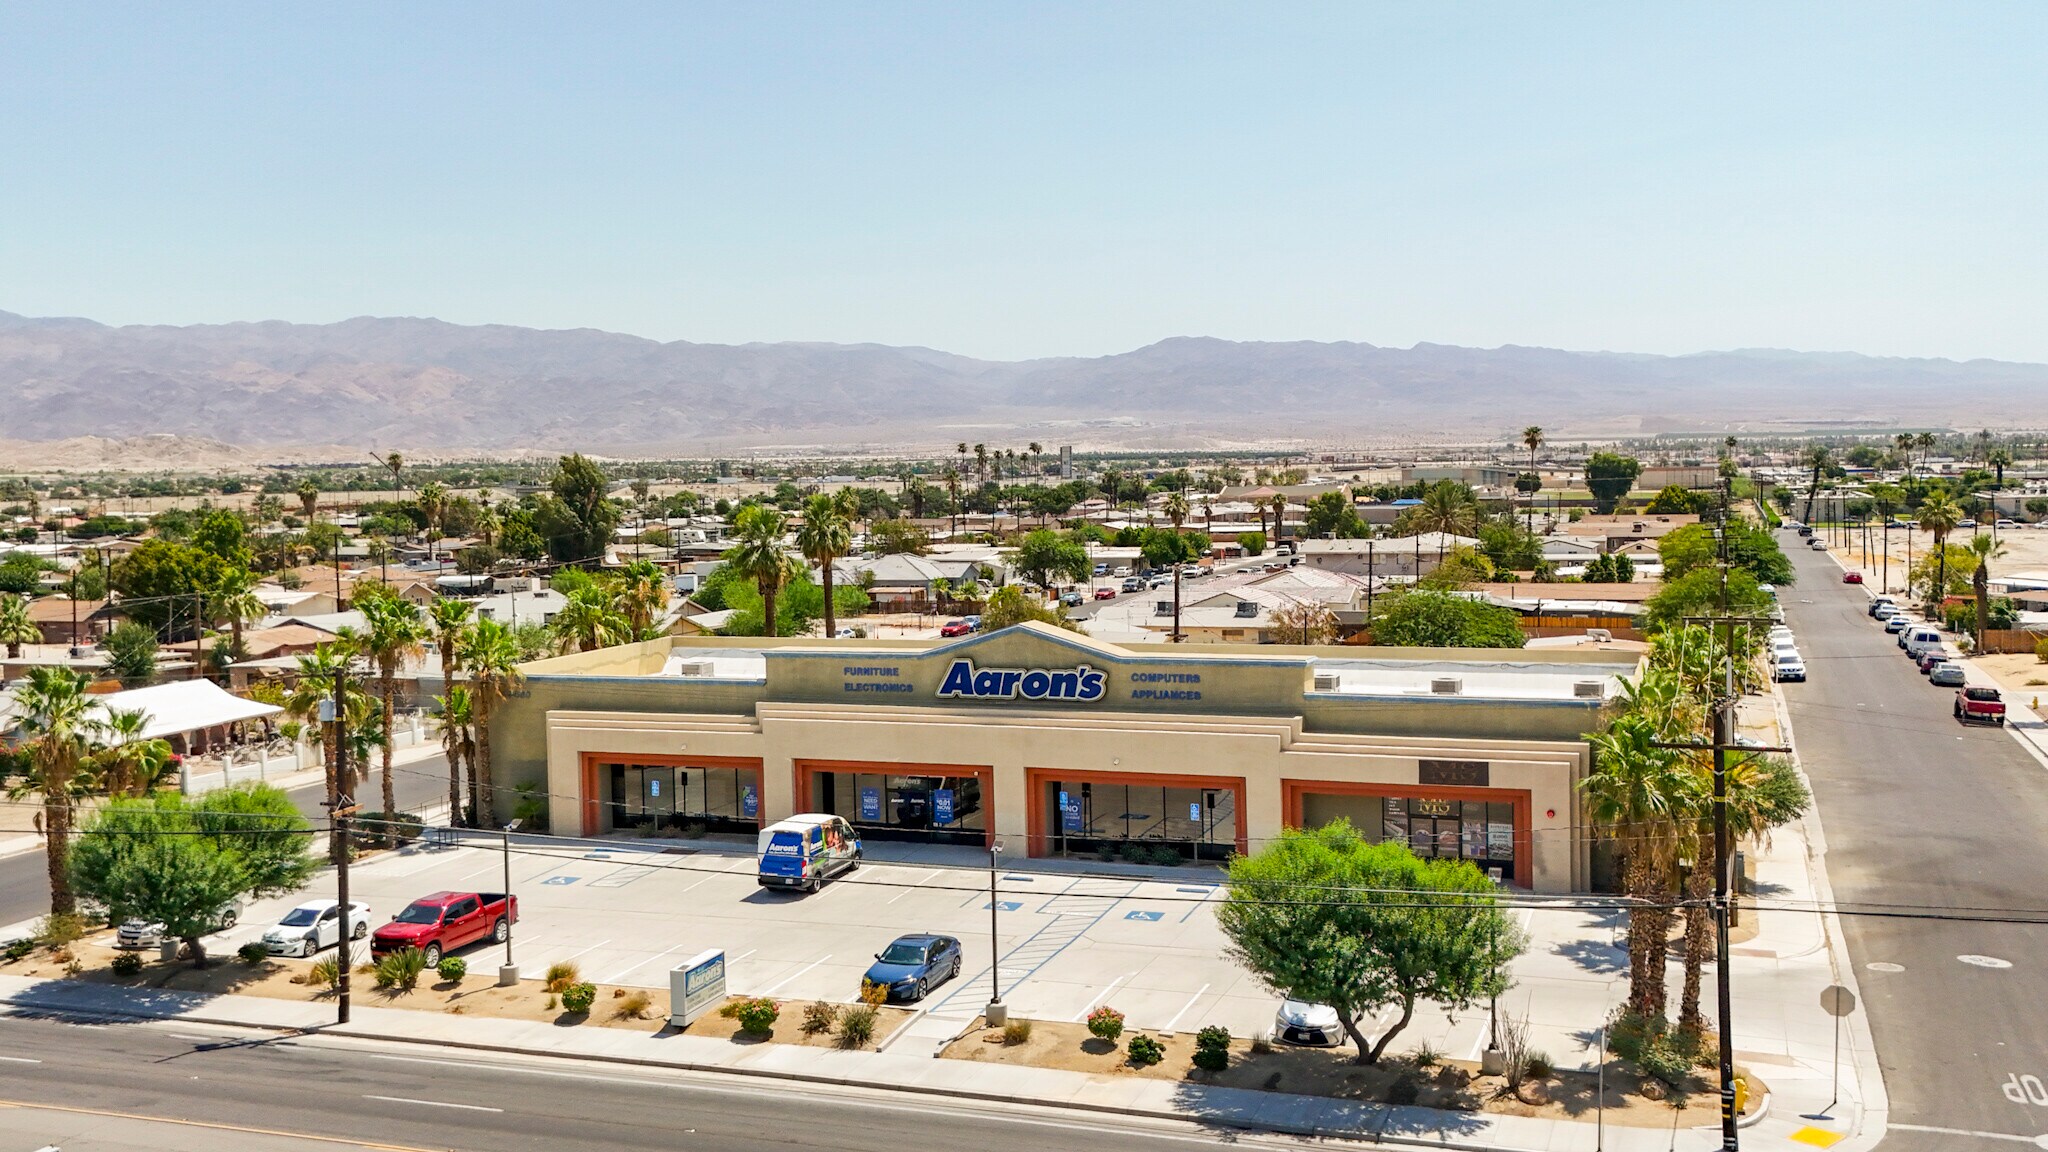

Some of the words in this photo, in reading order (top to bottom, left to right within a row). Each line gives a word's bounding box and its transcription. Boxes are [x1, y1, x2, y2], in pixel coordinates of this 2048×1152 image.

[844, 667, 899, 676] FURNITURE
[938, 661, 1104, 699] Aaron's
[1131, 673, 1200, 683] COMPUTERS
[844, 683, 913, 692] ELECTRONICS
[1132, 690, 1201, 700] APPLIANCES
[768, 843, 799, 852] Aaron's
[688, 960, 723, 994] Aaron's
